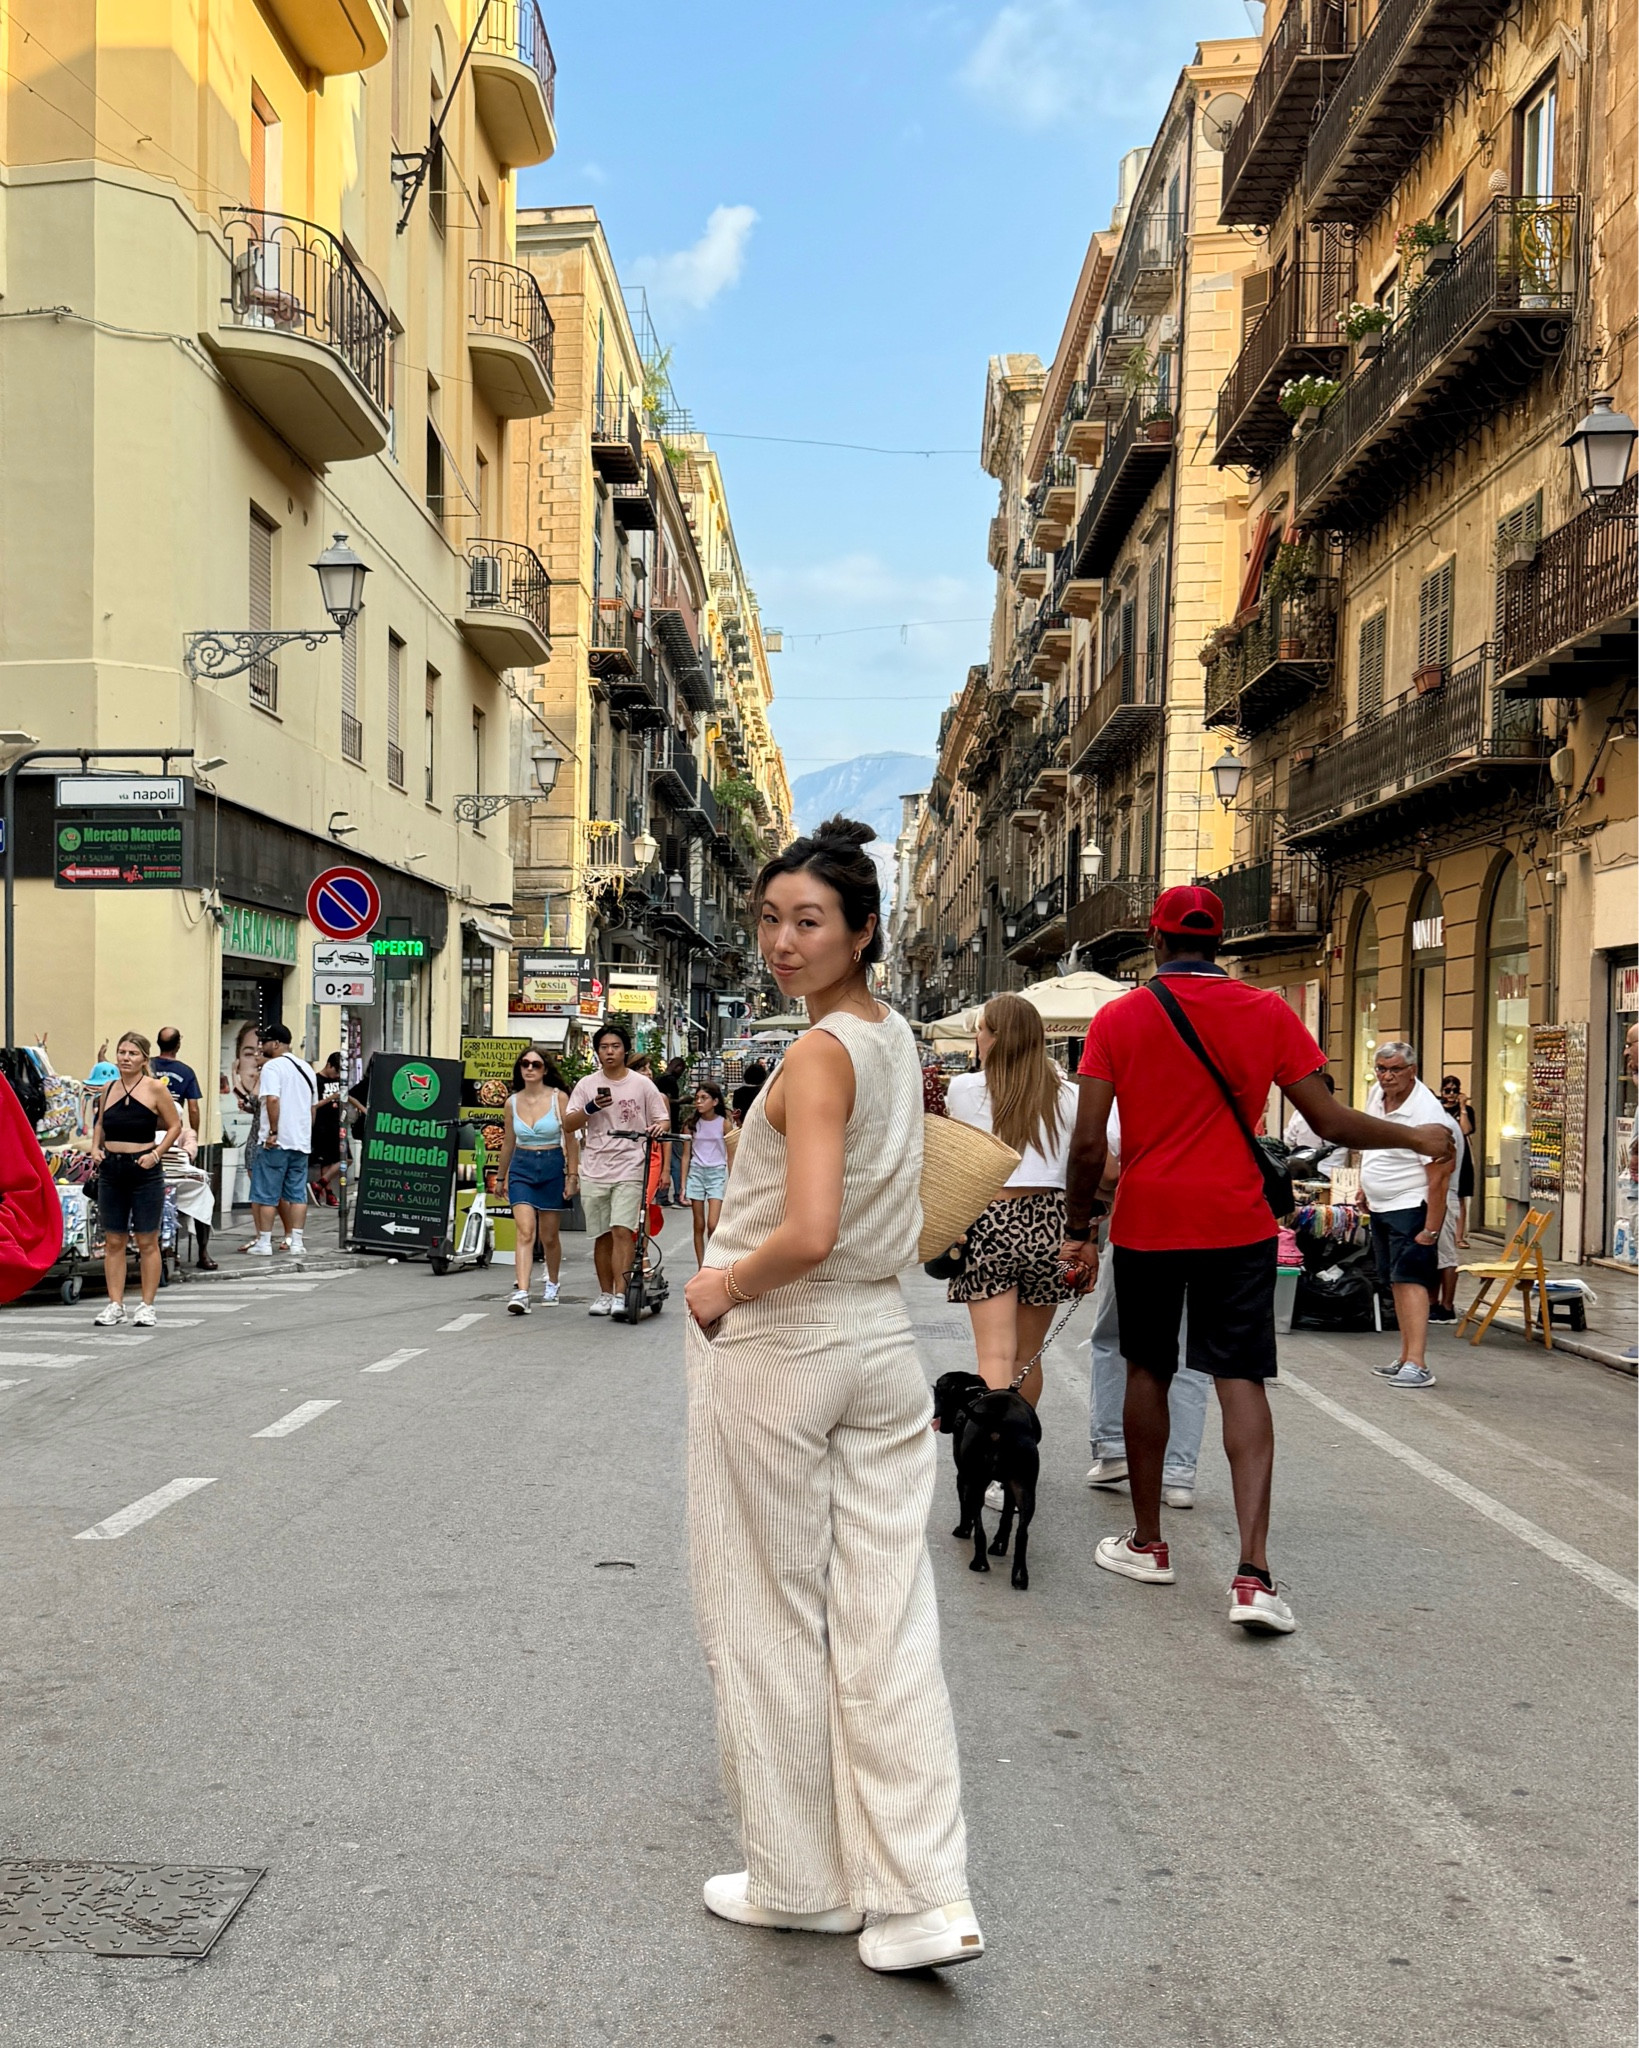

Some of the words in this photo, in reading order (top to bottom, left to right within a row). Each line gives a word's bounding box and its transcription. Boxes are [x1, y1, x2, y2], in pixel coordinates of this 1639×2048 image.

[133, 788, 174, 801] napoli
[84, 828, 129, 842] Mercato
[131, 827, 181, 843] Maqueda
[221, 904, 298, 962] FARMACIA
[374, 940, 424, 956] APERTA
[1119, 971, 1137, 979] BAR
[325, 983, 353, 996] 0-2
[479, 1069, 512, 1078] Pizzeria
[324, 1082, 340, 1093] JUST
[375, 1112, 448, 1139] Mercato
[368, 1139, 449, 1167] Maqueda
[369, 1177, 402, 1189] FRUTTA
[403, 1181, 411, 1191] &
[413, 1182, 441, 1194] ORTO
[367, 1190, 396, 1201] CARNI
[407, 1195, 441, 1206] SALUMI
